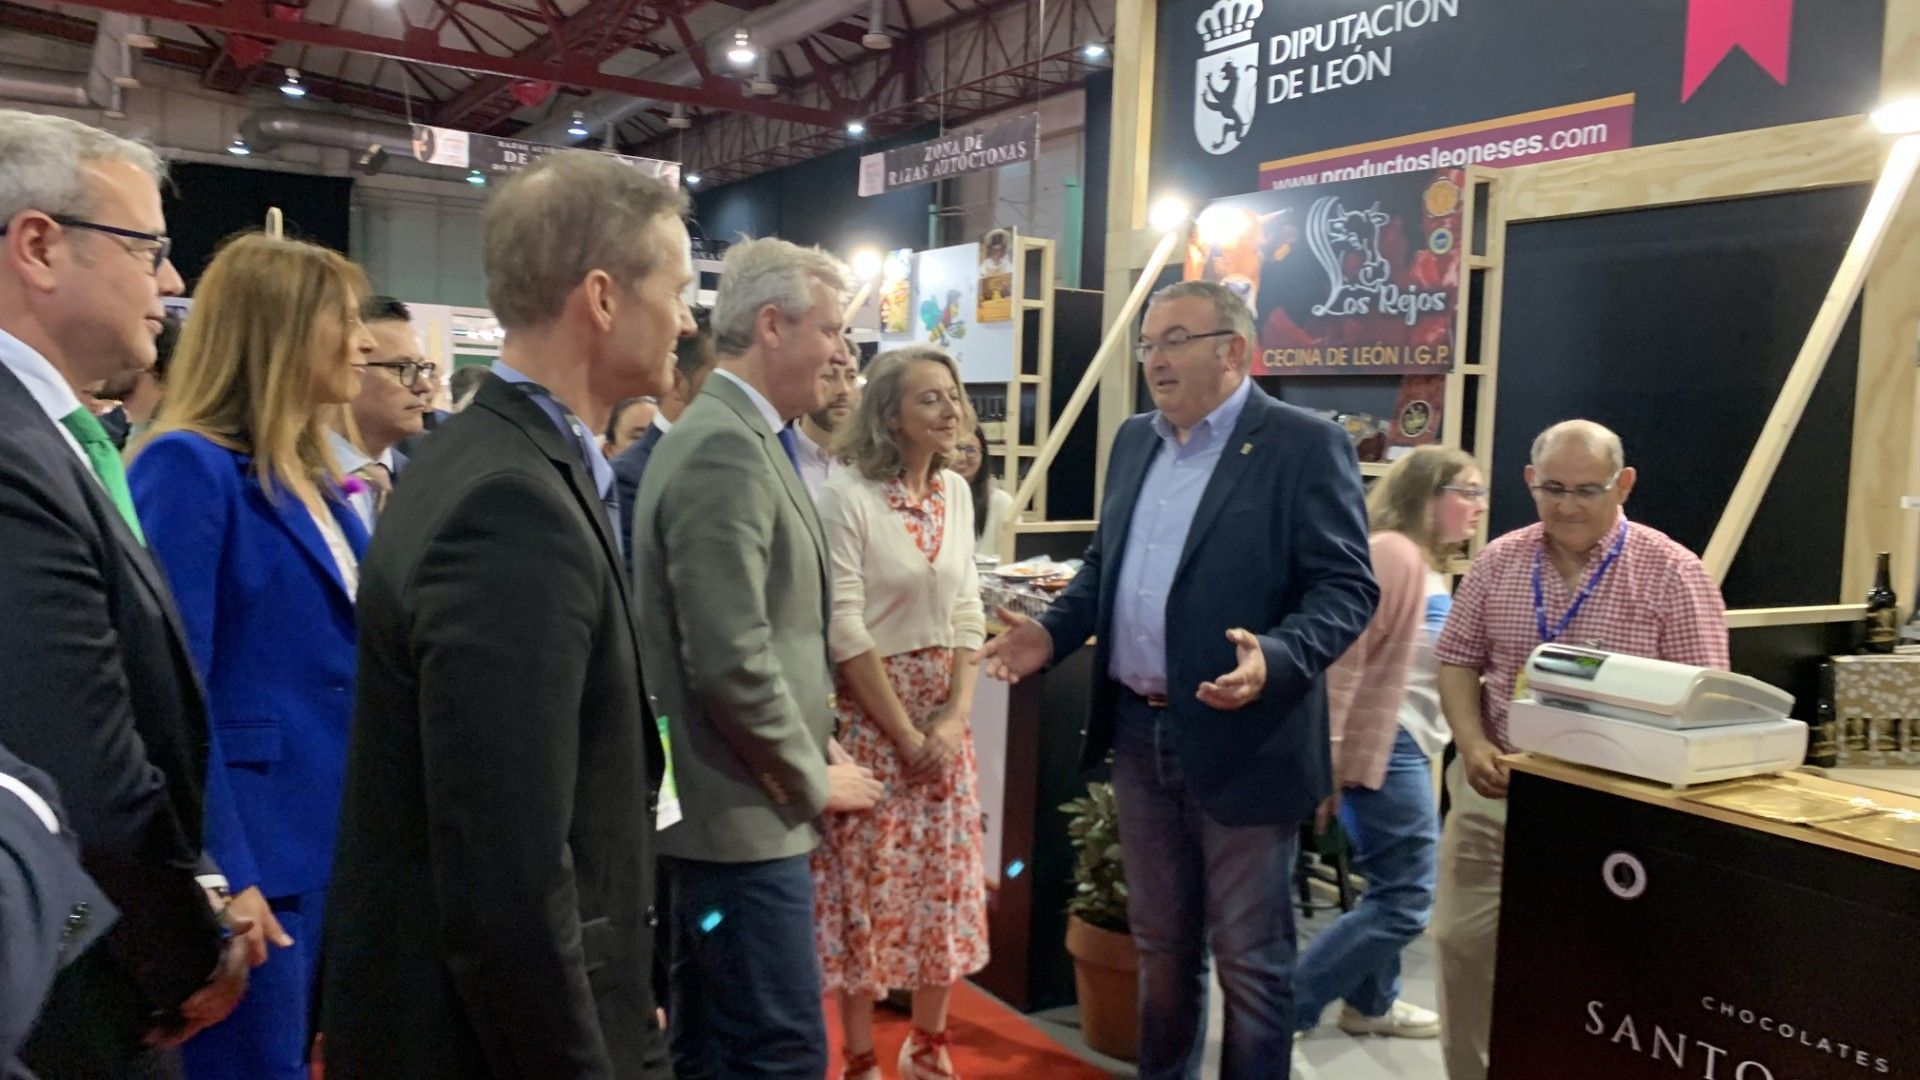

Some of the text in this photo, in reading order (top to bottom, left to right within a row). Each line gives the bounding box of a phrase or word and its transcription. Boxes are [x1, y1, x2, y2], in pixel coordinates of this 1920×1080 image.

[1267, 45, 1392, 104] DE LEÓN
[924, 134, 983, 162] ZONA DE
[888, 164, 929, 186] RAZAS
[1378, 283, 1446, 326] Rejos
[1262, 348, 1323, 367] CECINA
[1326, 347, 1349, 366] DE
[1353, 341, 1400, 366] LEÓN
[1702, 996, 1889, 1073] CHOCOLATES
